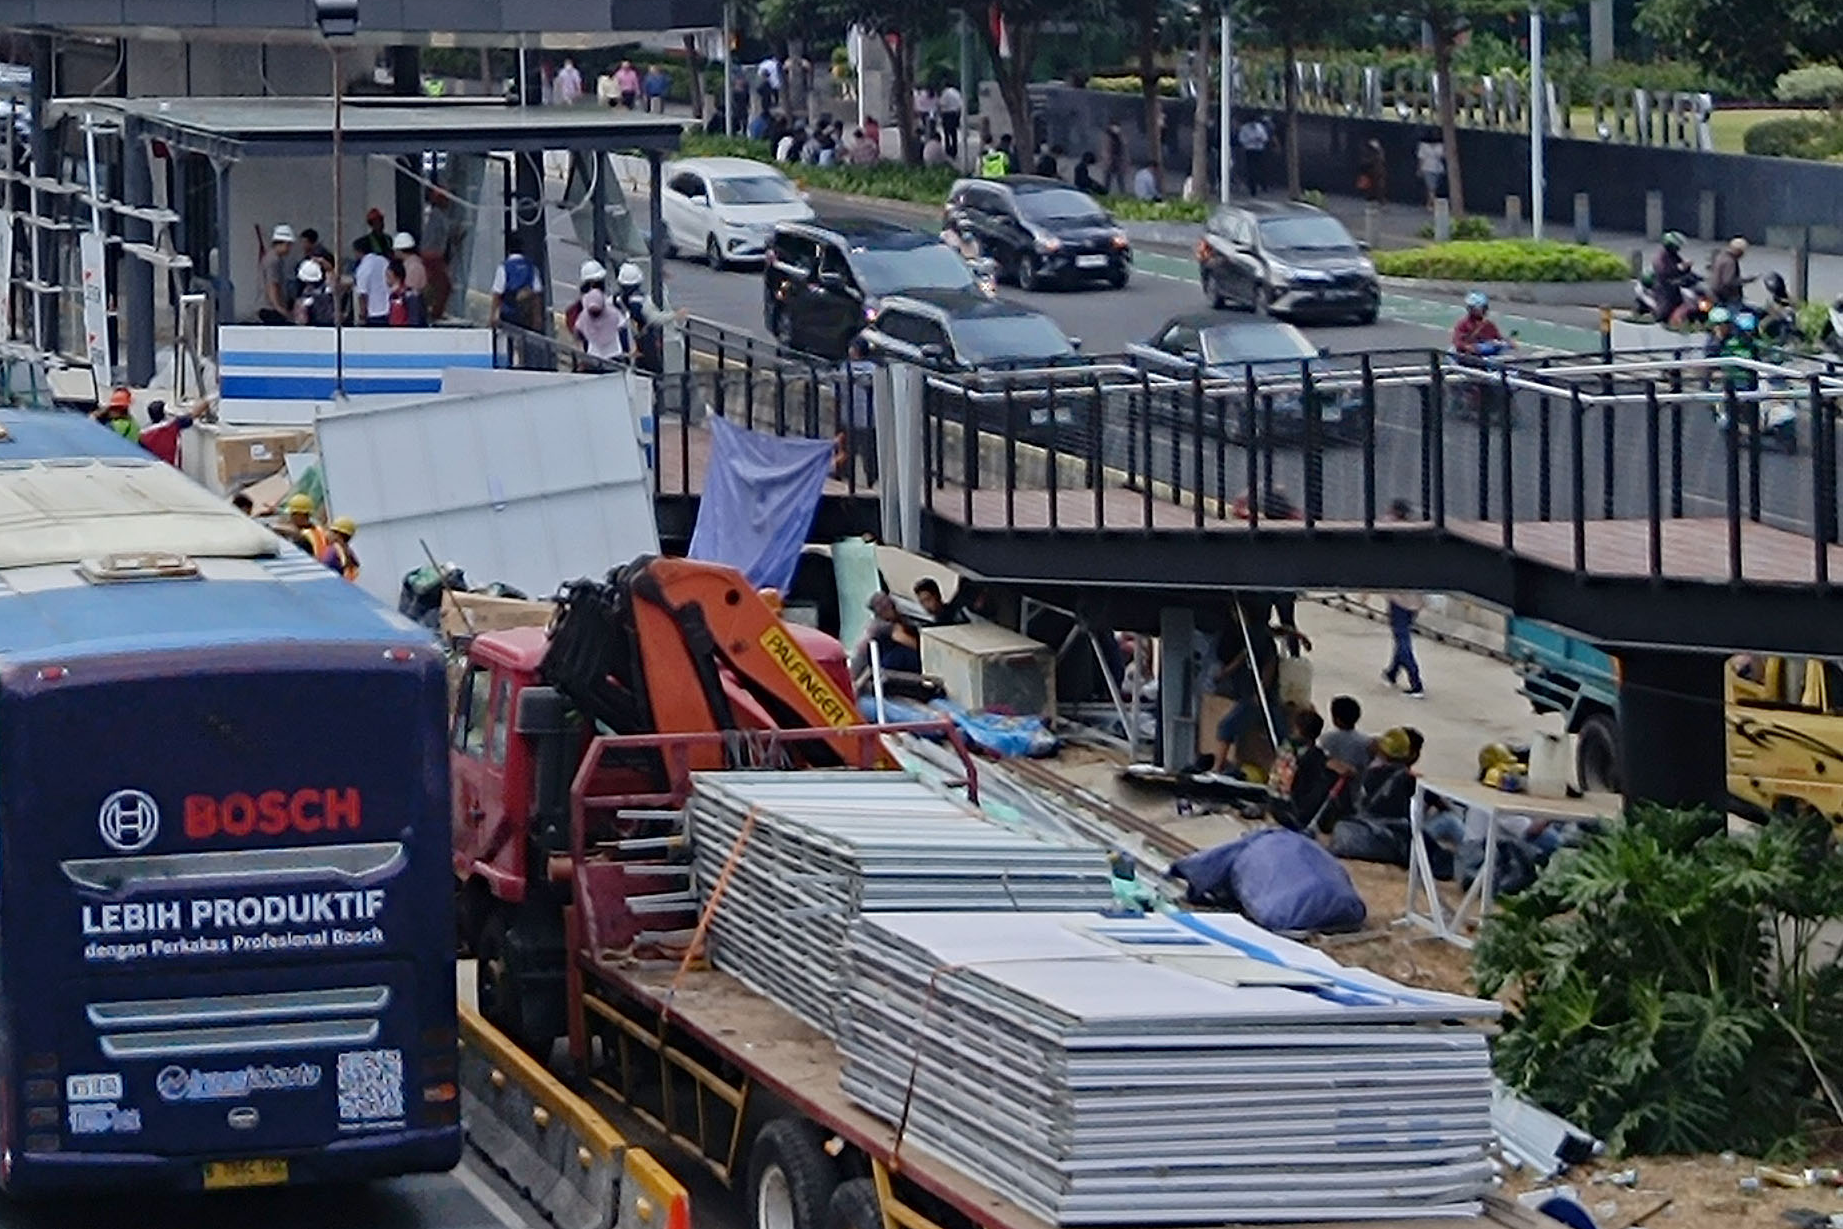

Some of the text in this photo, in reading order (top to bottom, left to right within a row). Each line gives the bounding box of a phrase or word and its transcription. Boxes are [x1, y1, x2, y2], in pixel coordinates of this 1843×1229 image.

[766, 634, 846, 724] PALFINGER
[182, 787, 363, 840] BOSCH
[81, 889, 386, 936] LEBIH PRODUKTIF
[83, 926, 385, 962] dengan Perkakas Profesional Bosch
